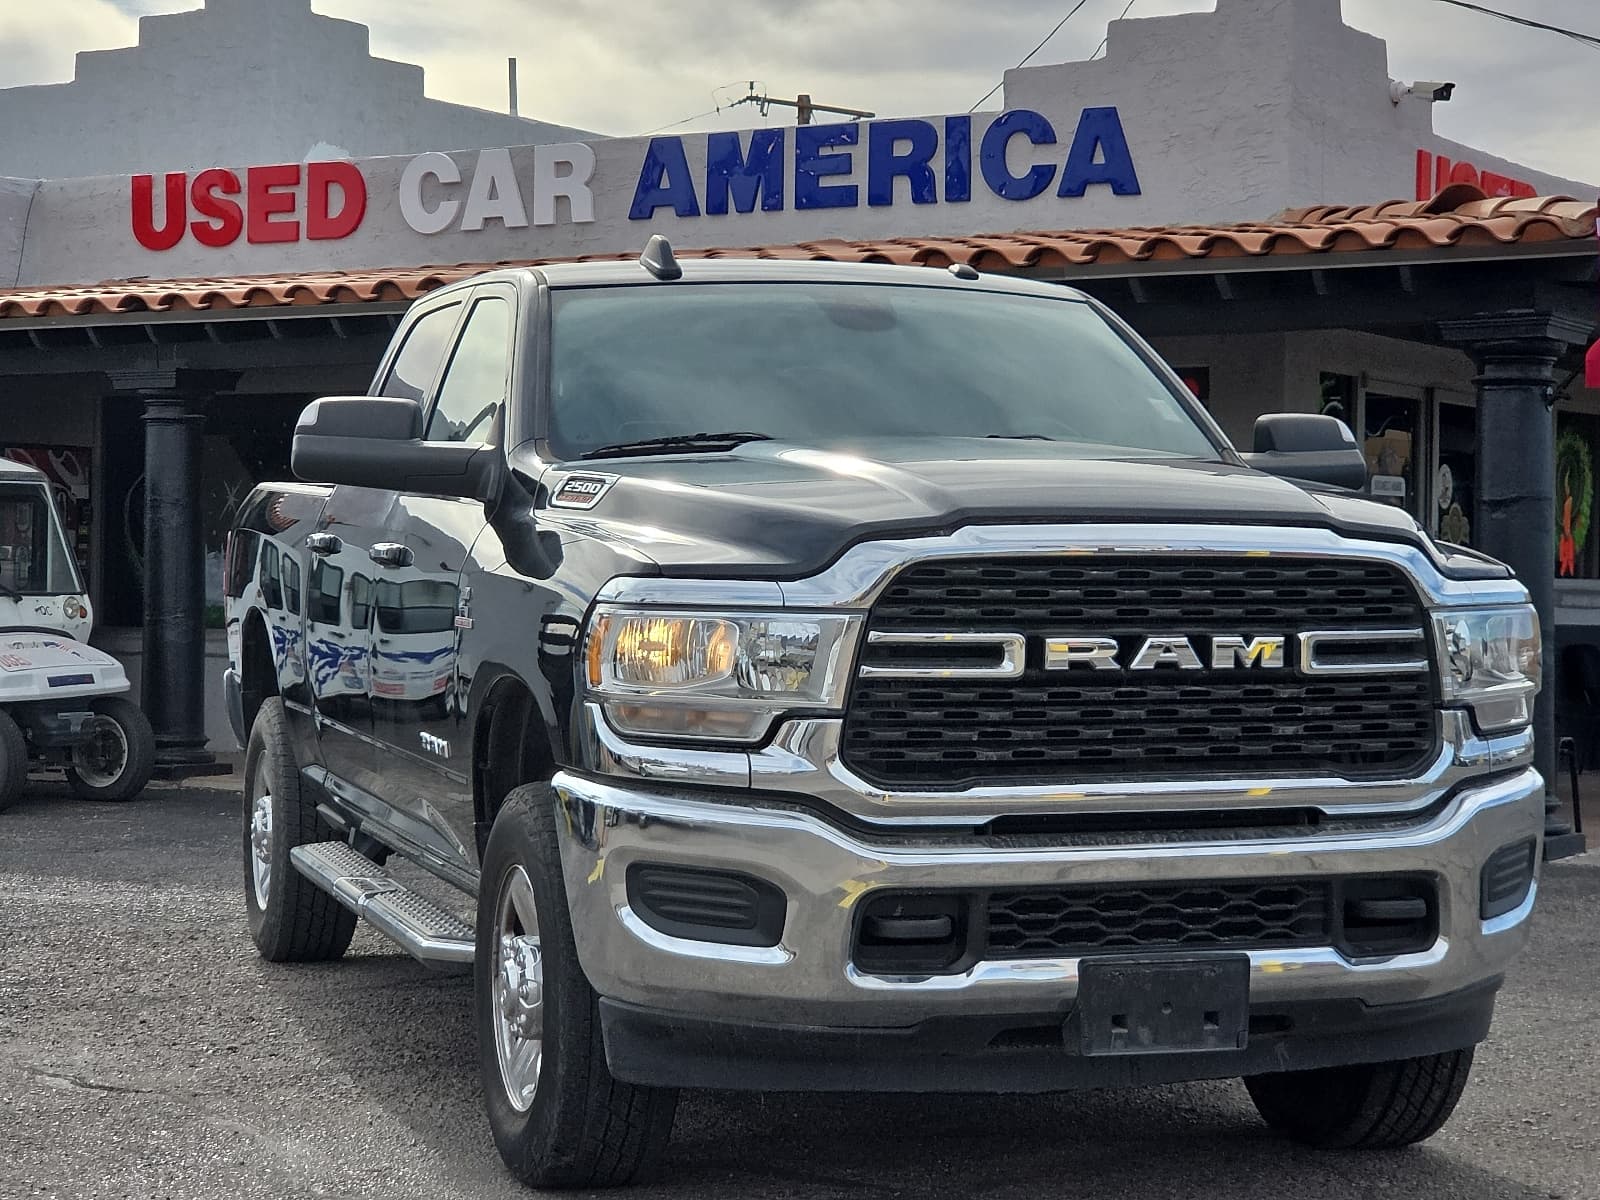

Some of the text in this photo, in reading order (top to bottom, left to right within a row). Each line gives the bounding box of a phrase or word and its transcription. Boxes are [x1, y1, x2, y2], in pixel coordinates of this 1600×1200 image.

[131, 105, 1143, 251] USED CAR AMERICA
[563, 480, 602, 494] 2500
[1044, 636, 1286, 670] RAM
